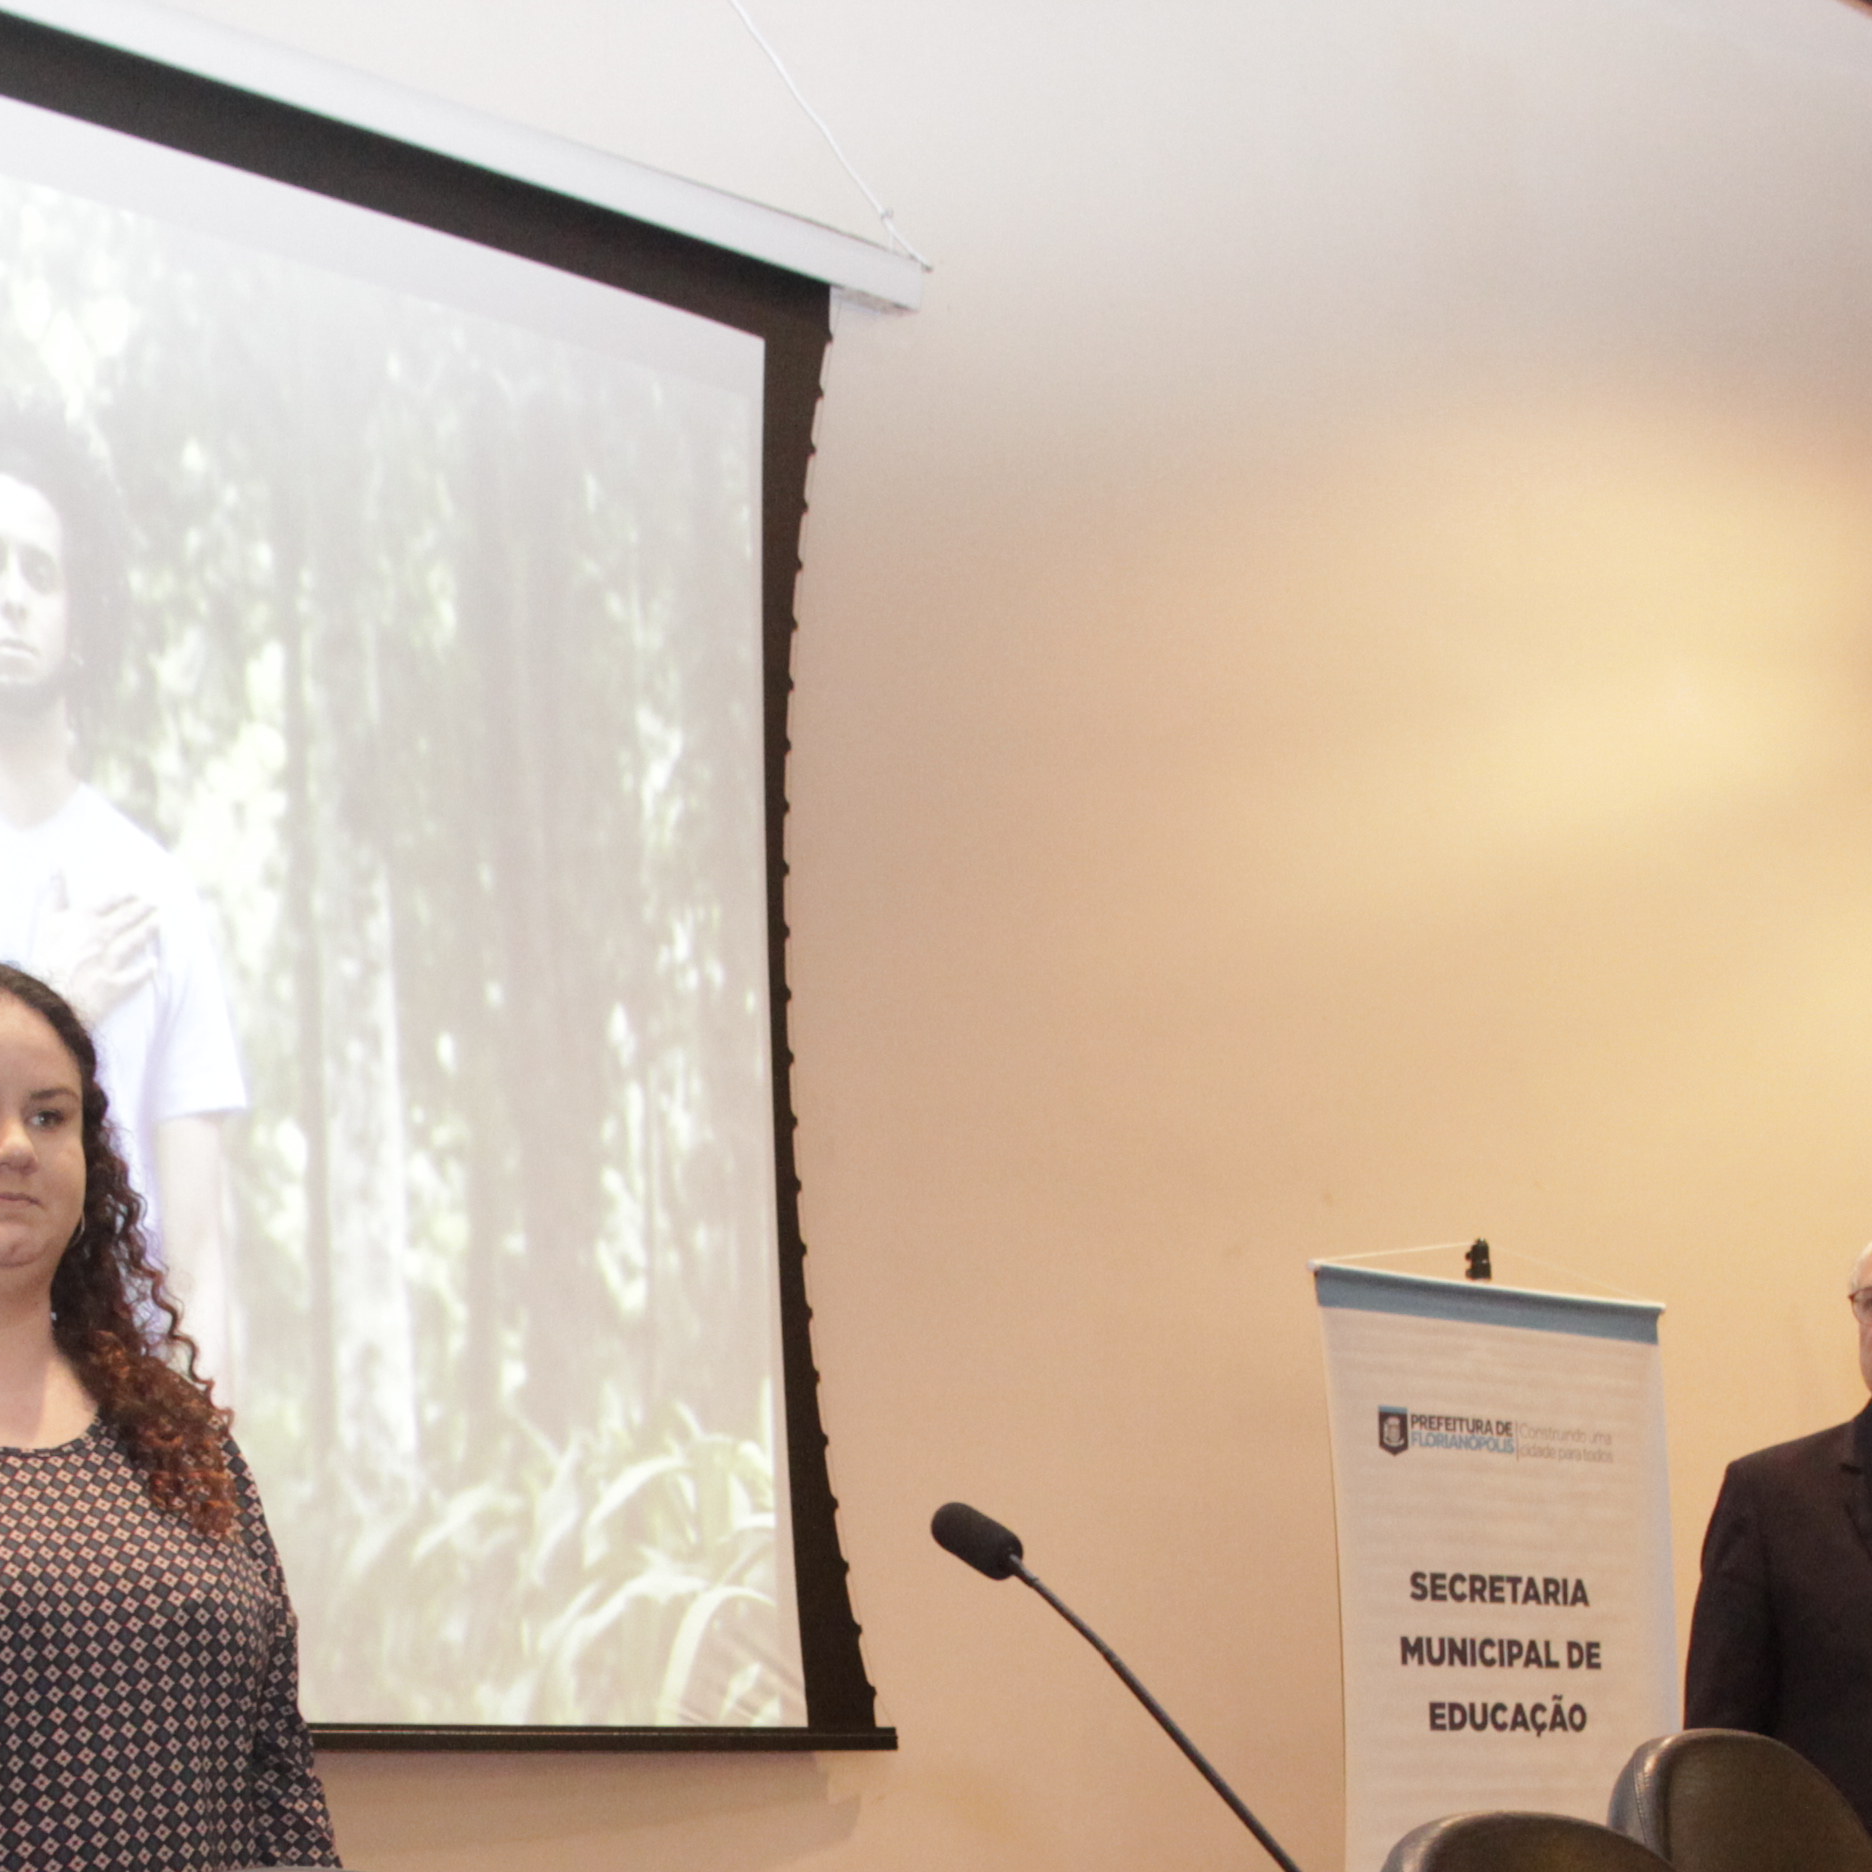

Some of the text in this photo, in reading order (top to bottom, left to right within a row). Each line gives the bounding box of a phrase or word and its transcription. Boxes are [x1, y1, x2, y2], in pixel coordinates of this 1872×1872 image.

[1410, 1413, 1513, 1437] PREFEITURA DE
[1519, 1422, 1587, 1443] Construindo
[1411, 1432, 1515, 1454] FLORIANÓPOLIS
[1409, 1571, 1589, 1607] SECRETARIA
[1400, 1636, 1602, 1669] MUNICIPAL DE
[1428, 1694, 1588, 1738] EDUCAÇÃO
